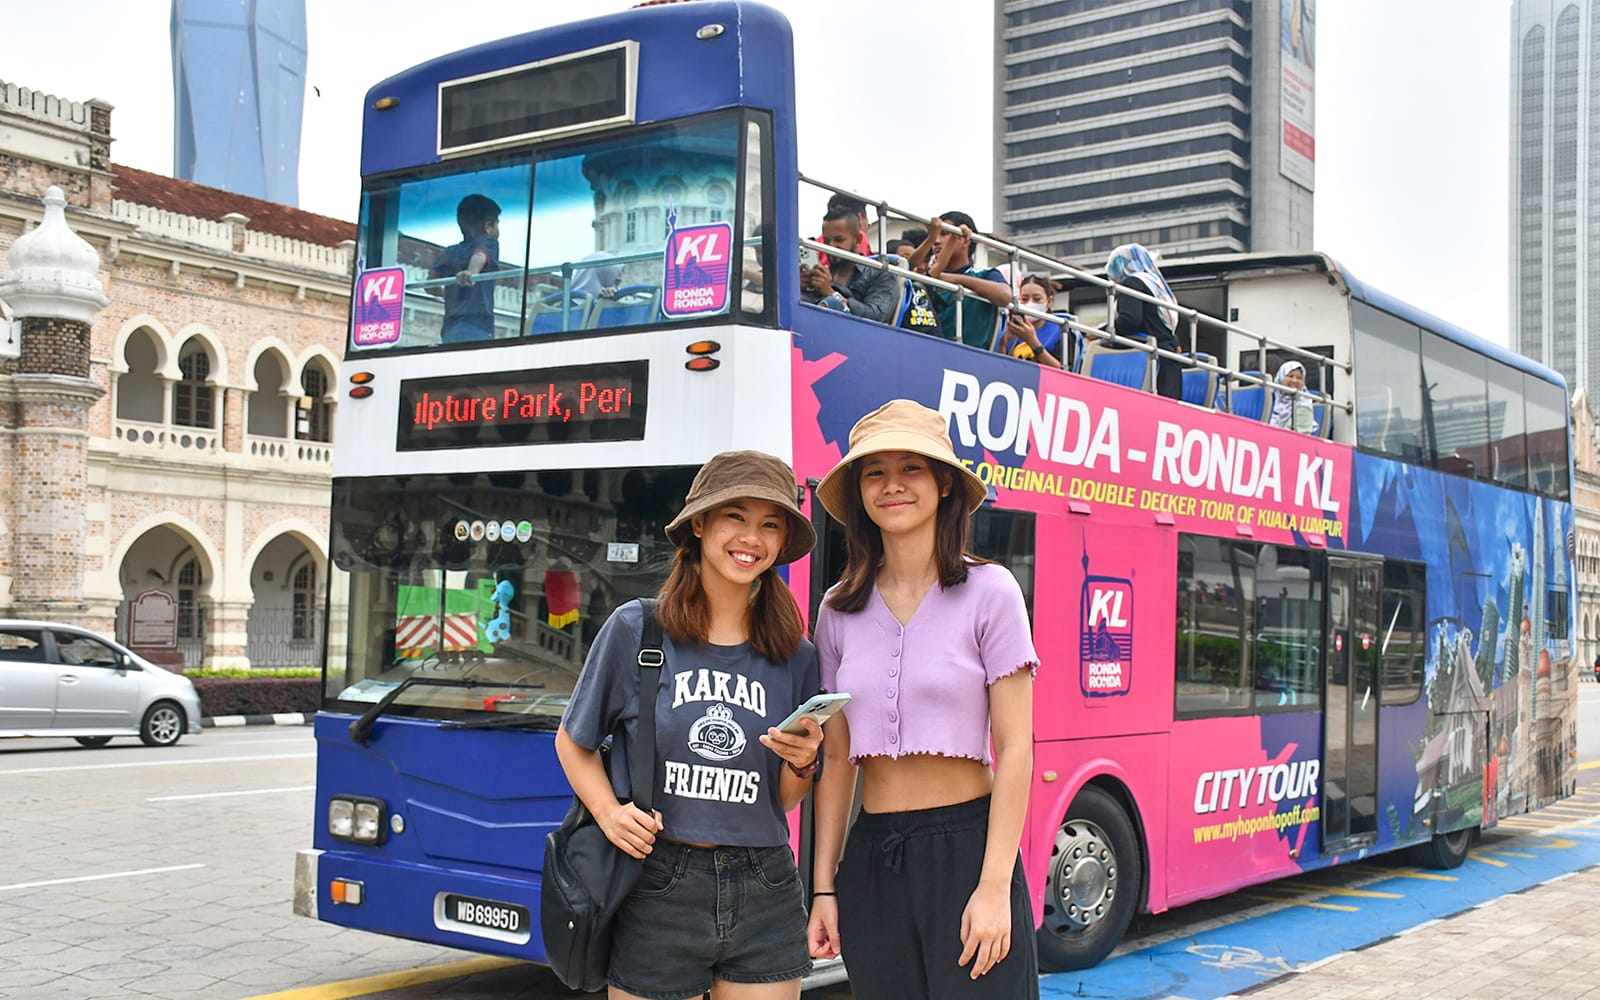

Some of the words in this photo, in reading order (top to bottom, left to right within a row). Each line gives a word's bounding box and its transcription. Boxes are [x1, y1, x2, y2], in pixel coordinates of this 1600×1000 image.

[675, 234, 723, 265] KL
[364, 276, 398, 303] KL
[673, 296, 714, 309] RONDA
[674, 287, 715, 299] RONDA
[359, 331, 395, 342] HOP-OFF
[360, 322, 394, 333] HOP-ON
[503, 384, 571, 422] Park,
[580, 382, 632, 414] Per
[938, 368, 1120, 473] RONDA
[1152, 420, 1282, 503] RONDA
[1295, 453, 1340, 513] KL
[976, 462, 1065, 497] ORIGINAL
[1068, 477, 1136, 508] DOUBLE
[1139, 489, 1196, 517] DECKER
[1200, 499, 1235, 523] TOUR
[1236, 505, 1255, 525] OF
[1257, 508, 1297, 532] KUALA
[1299, 515, 1343, 538] LUMPUR
[1088, 589, 1127, 628] KL
[1088, 662, 1122, 675] RONDA
[1088, 675, 1122, 688] RONDA
[672, 668, 767, 718] KAKAO
[663, 760, 761, 804] FRIENDS
[1193, 767, 1256, 814] CITY
[1256, 759, 1320, 805] TOUR
[1193, 804, 1320, 844] www.myhoponhopoff.com
